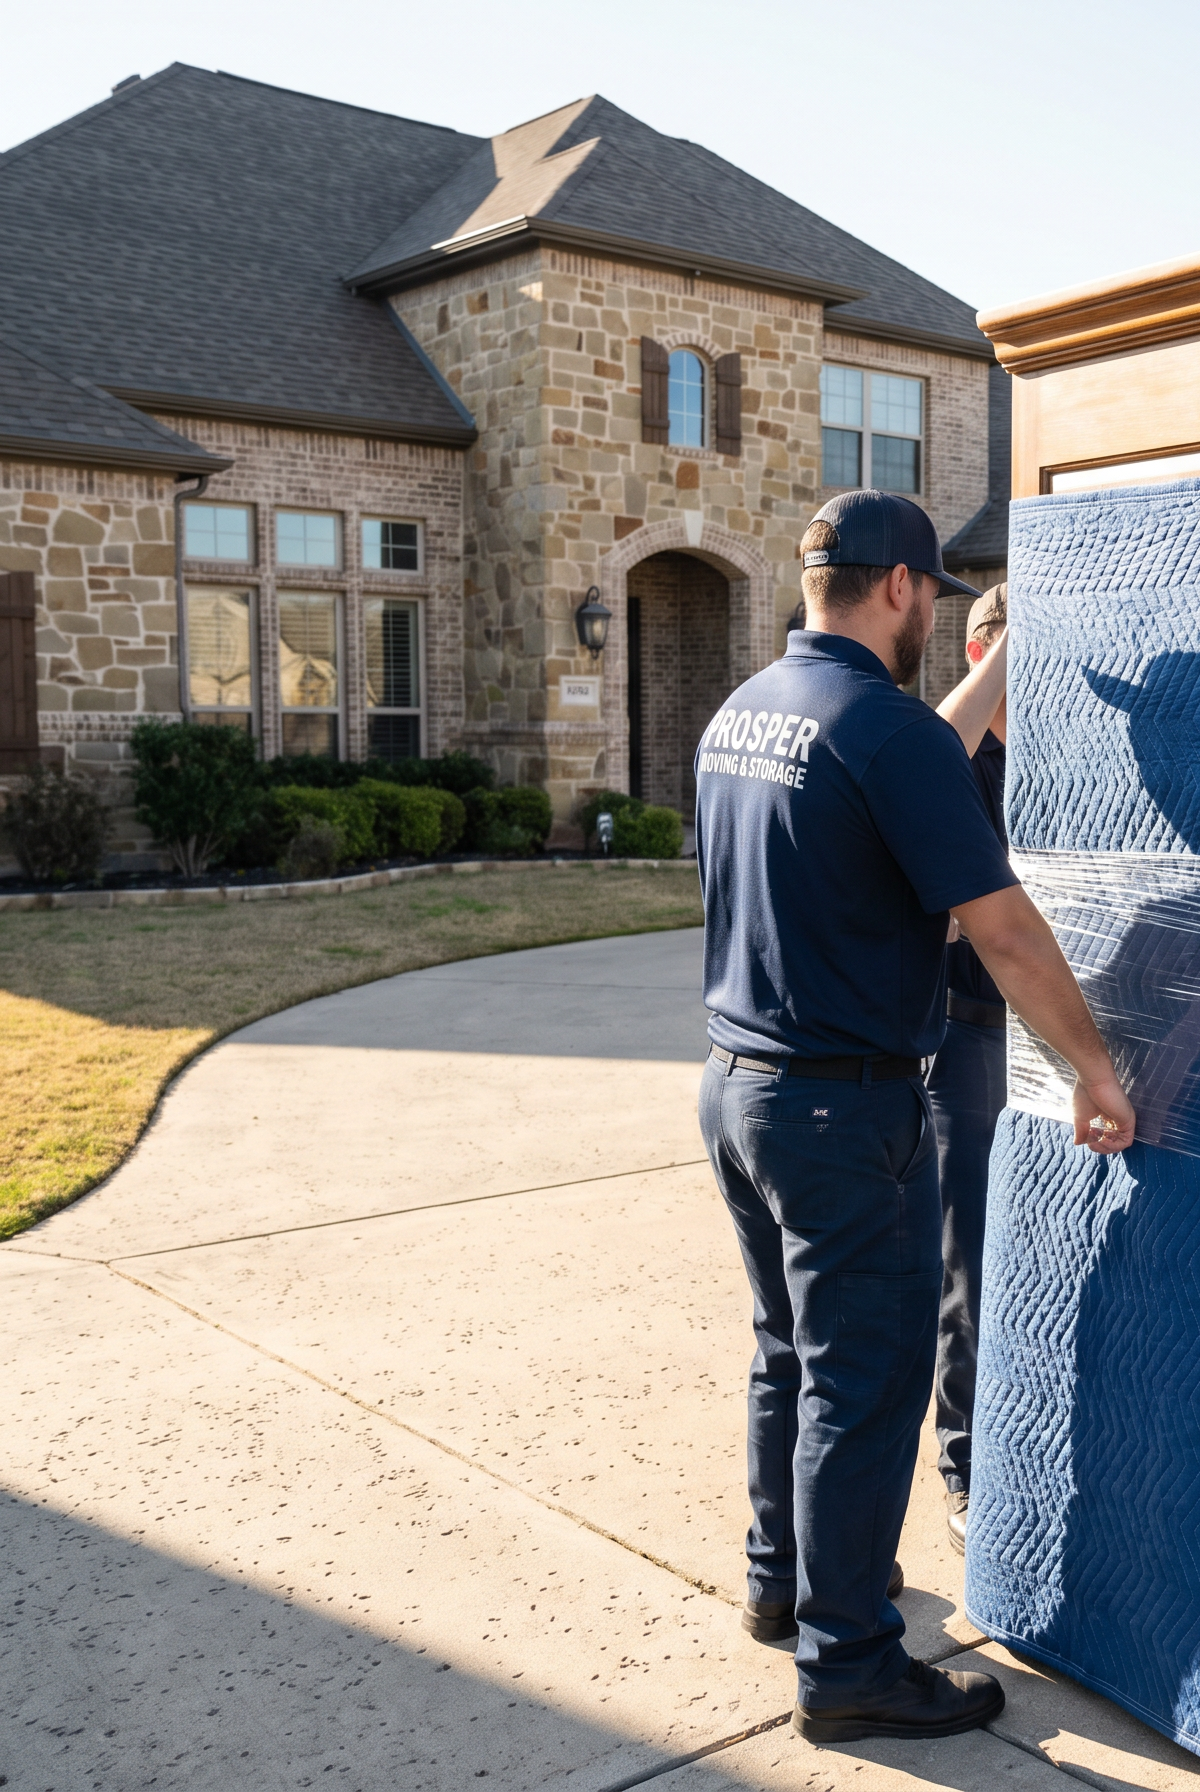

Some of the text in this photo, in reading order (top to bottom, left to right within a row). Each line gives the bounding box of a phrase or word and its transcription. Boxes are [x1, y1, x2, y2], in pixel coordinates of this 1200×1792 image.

[703, 708, 820, 763] PROSPER
[739, 755, 748, 777] &
[748, 757, 807, 790] STORAGE
